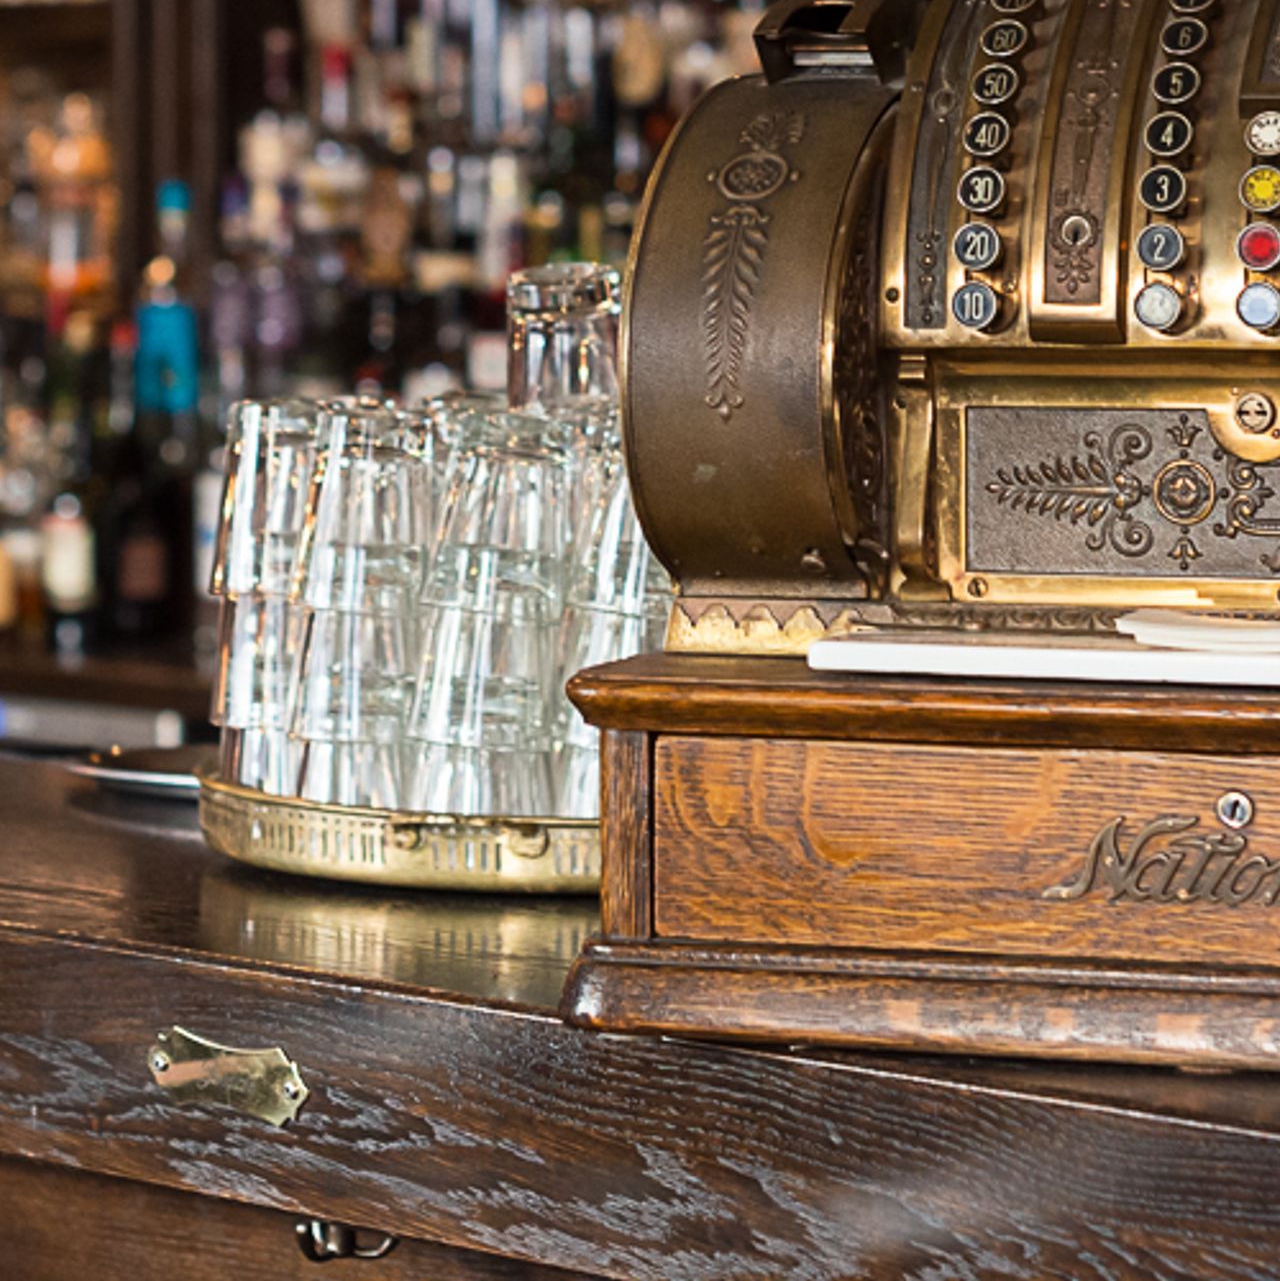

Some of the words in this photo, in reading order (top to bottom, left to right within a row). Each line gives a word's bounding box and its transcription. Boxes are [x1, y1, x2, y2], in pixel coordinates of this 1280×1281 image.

[992, 28, 1017, 50] 60
[1178, 26, 1193, 47] 6
[983, 73, 1008, 97] 50
[1170, 71, 1185, 96] 5
[974, 122, 999, 148] 40
[1160, 122, 1175, 147] 4
[969, 176, 994, 204] 30
[1156, 174, 1170, 202] 3
[965, 231, 989, 261] 20
[1153, 233, 1170, 262] 2
[963, 292, 983, 319] 10
